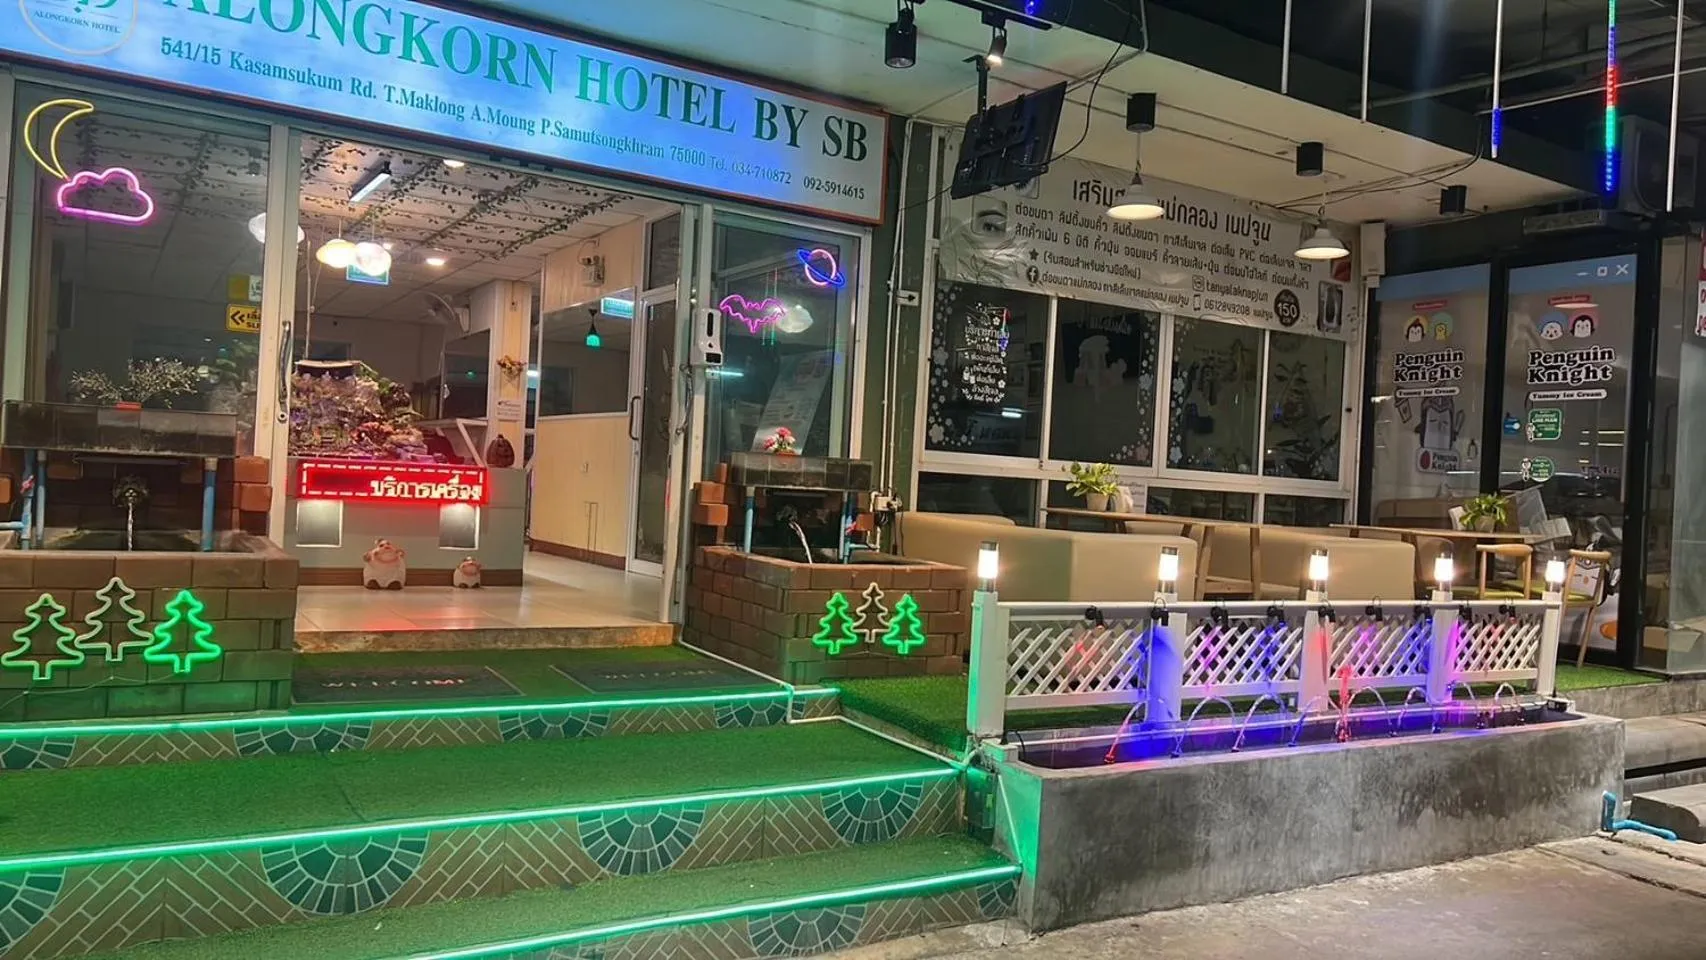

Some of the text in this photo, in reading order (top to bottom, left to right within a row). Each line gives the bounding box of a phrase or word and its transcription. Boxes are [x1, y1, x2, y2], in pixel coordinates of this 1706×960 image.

[34, 10, 121, 33] ALONGKORN HOTEL
[160, 36, 221, 67] 541/15
[229, 51, 342, 92] Kasamsukum
[349, 70, 377, 99] Rd.
[383, 84, 465, 121] T.Maklong
[470, 101, 535, 136] A.Moung
[670, 144, 706, 167] 75000
[731, 160, 792, 184] 034-710872
[803, 176, 865, 200] 092-5914615
[575, 54, 736, 133] HOTEL
[753, 97, 809, 148] BY
[822, 115, 868, 162] SB
[1015, 202, 1054, 221] ต่อขนตา
[1240, 248, 1256, 262] PVC
[1063, 232, 1070, 245] 6
[1226, 213, 1272, 246] เนปจูน
[1277, 302, 1297, 318] 150
[1395, 348, 1464, 367] Penguin
[1530, 346, 1615, 367] Penguin
[1393, 364, 1463, 383] Knight
[1528, 364, 1613, 386] Knight
